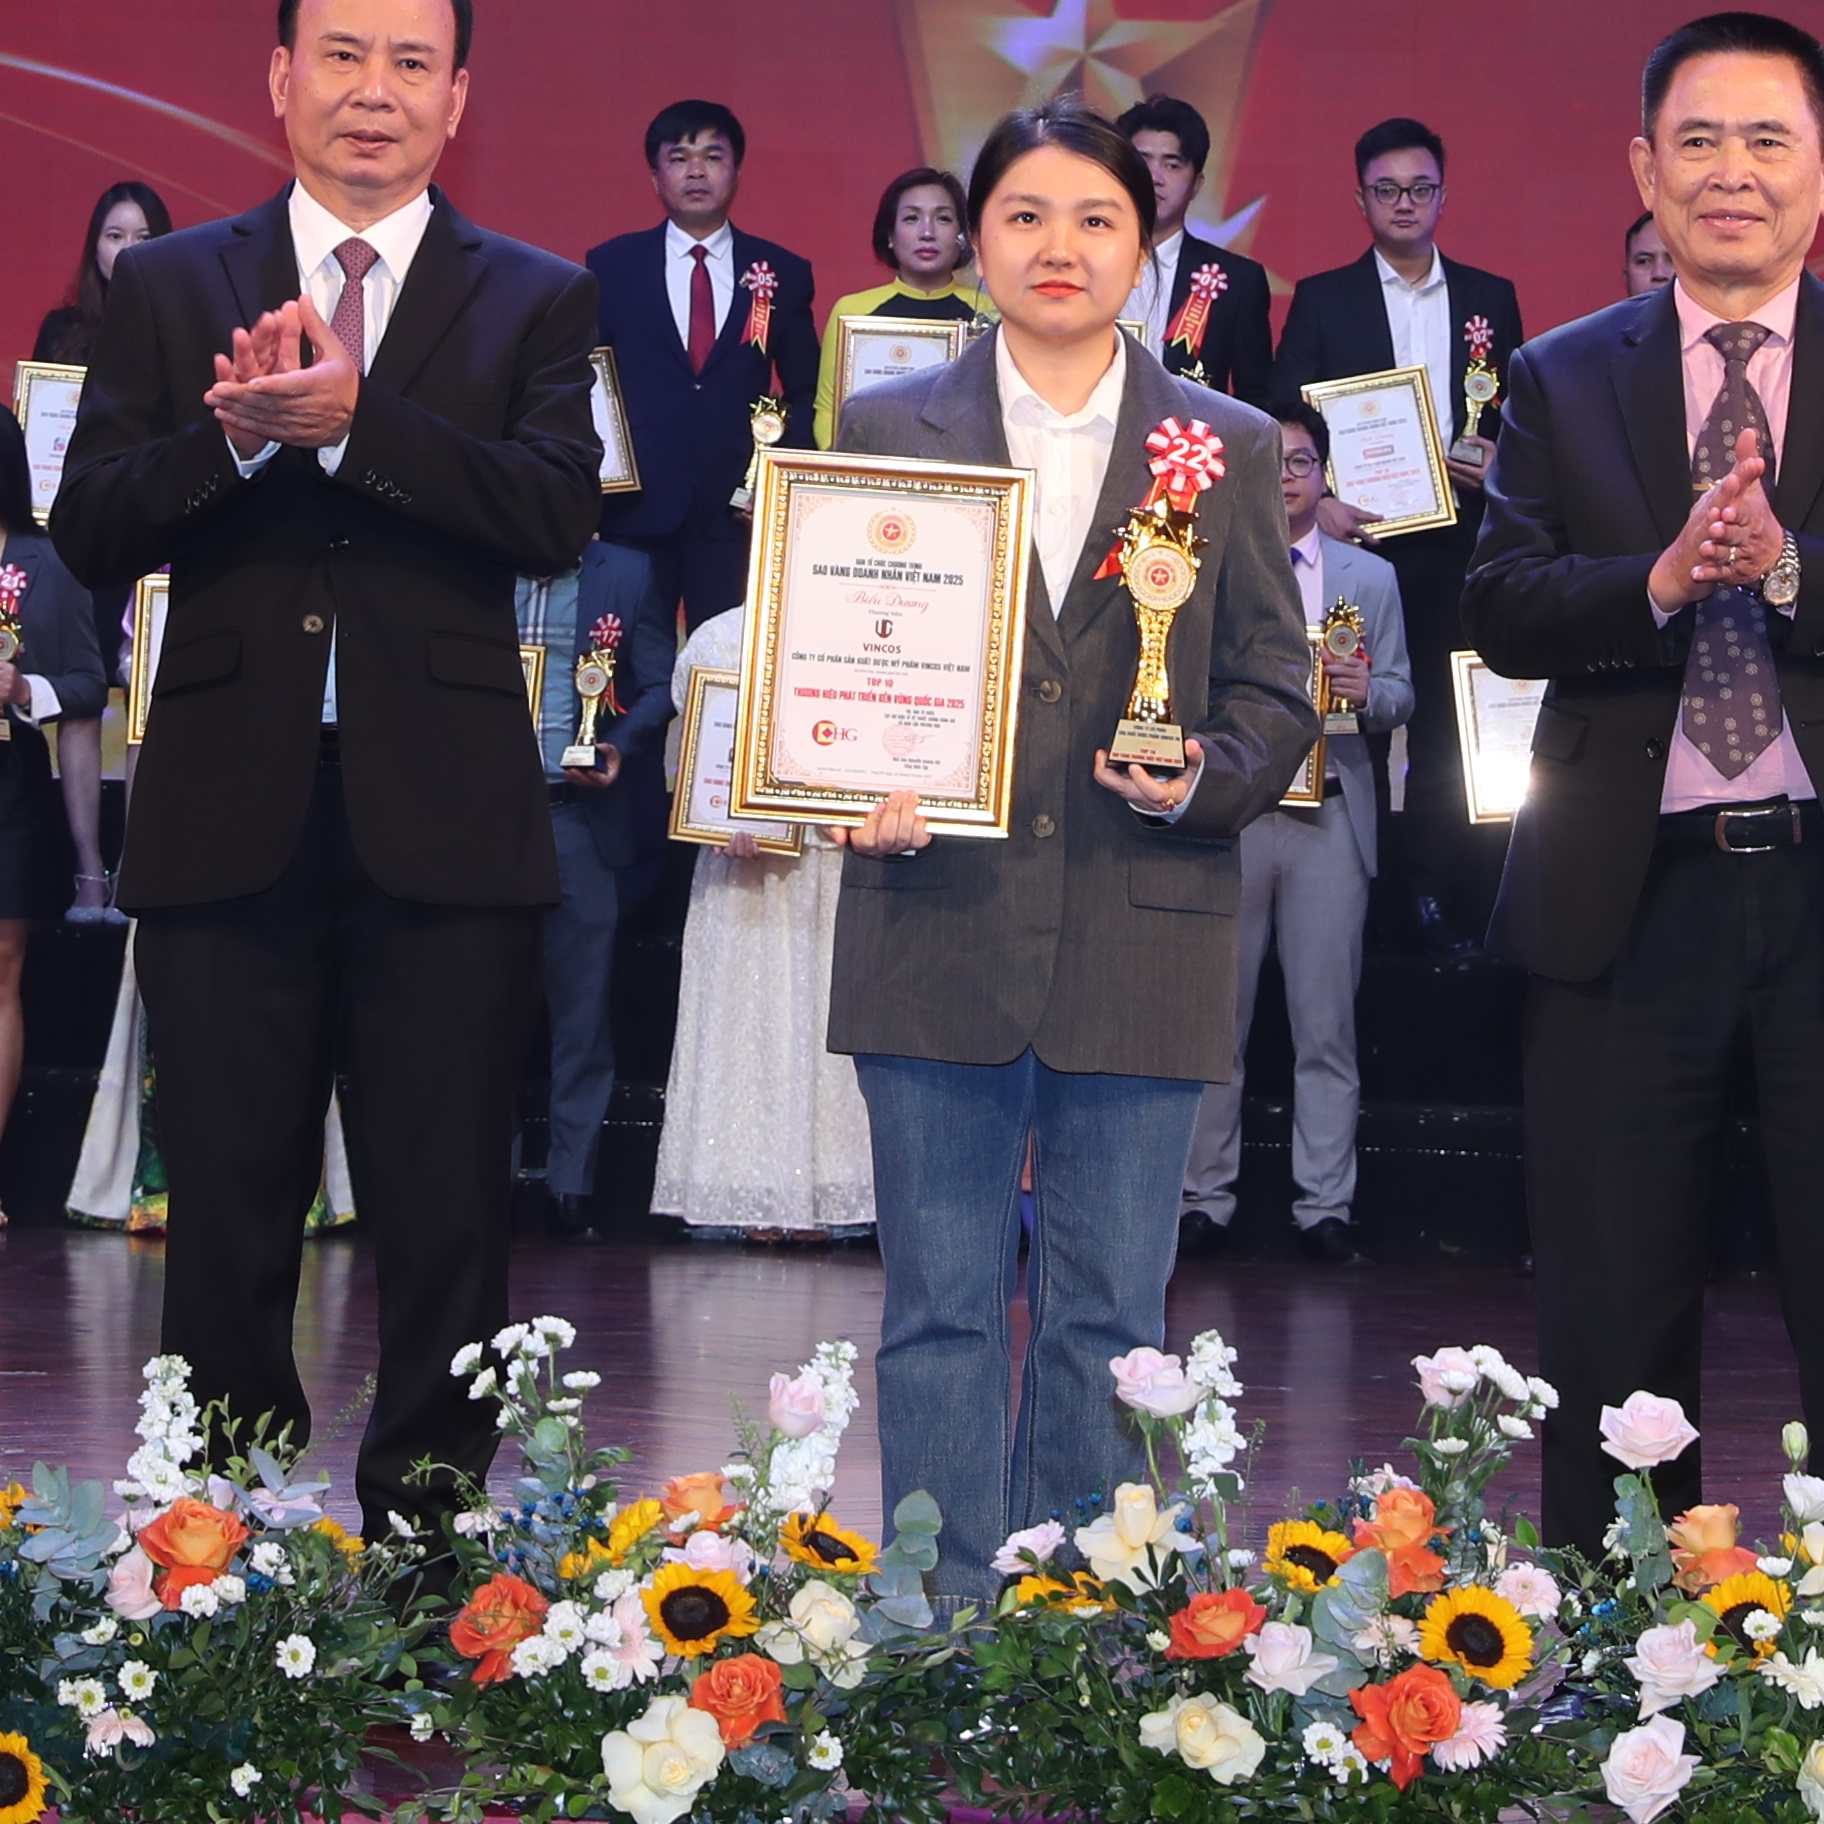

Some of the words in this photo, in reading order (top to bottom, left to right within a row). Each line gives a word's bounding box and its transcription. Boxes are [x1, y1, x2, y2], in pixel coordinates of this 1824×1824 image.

[1200, 273, 1217, 290] 01
[1473, 329, 1488, 344] 02
[1168, 437, 1208, 470] 22
[1, 573, 19, 588] 21
[813, 564, 828, 576] SAO
[830, 564, 850, 577] VÀNG
[853, 567, 879, 579] DOANH
[923, 572, 941, 584] NAM
[943, 573, 964, 586] 2025
[603, 629, 617, 643] 17
[863, 642, 902, 654] VINCOS
[867, 677, 882, 687] TOP
[884, 679, 894, 688] 10
[947, 698, 965, 709] 2025
